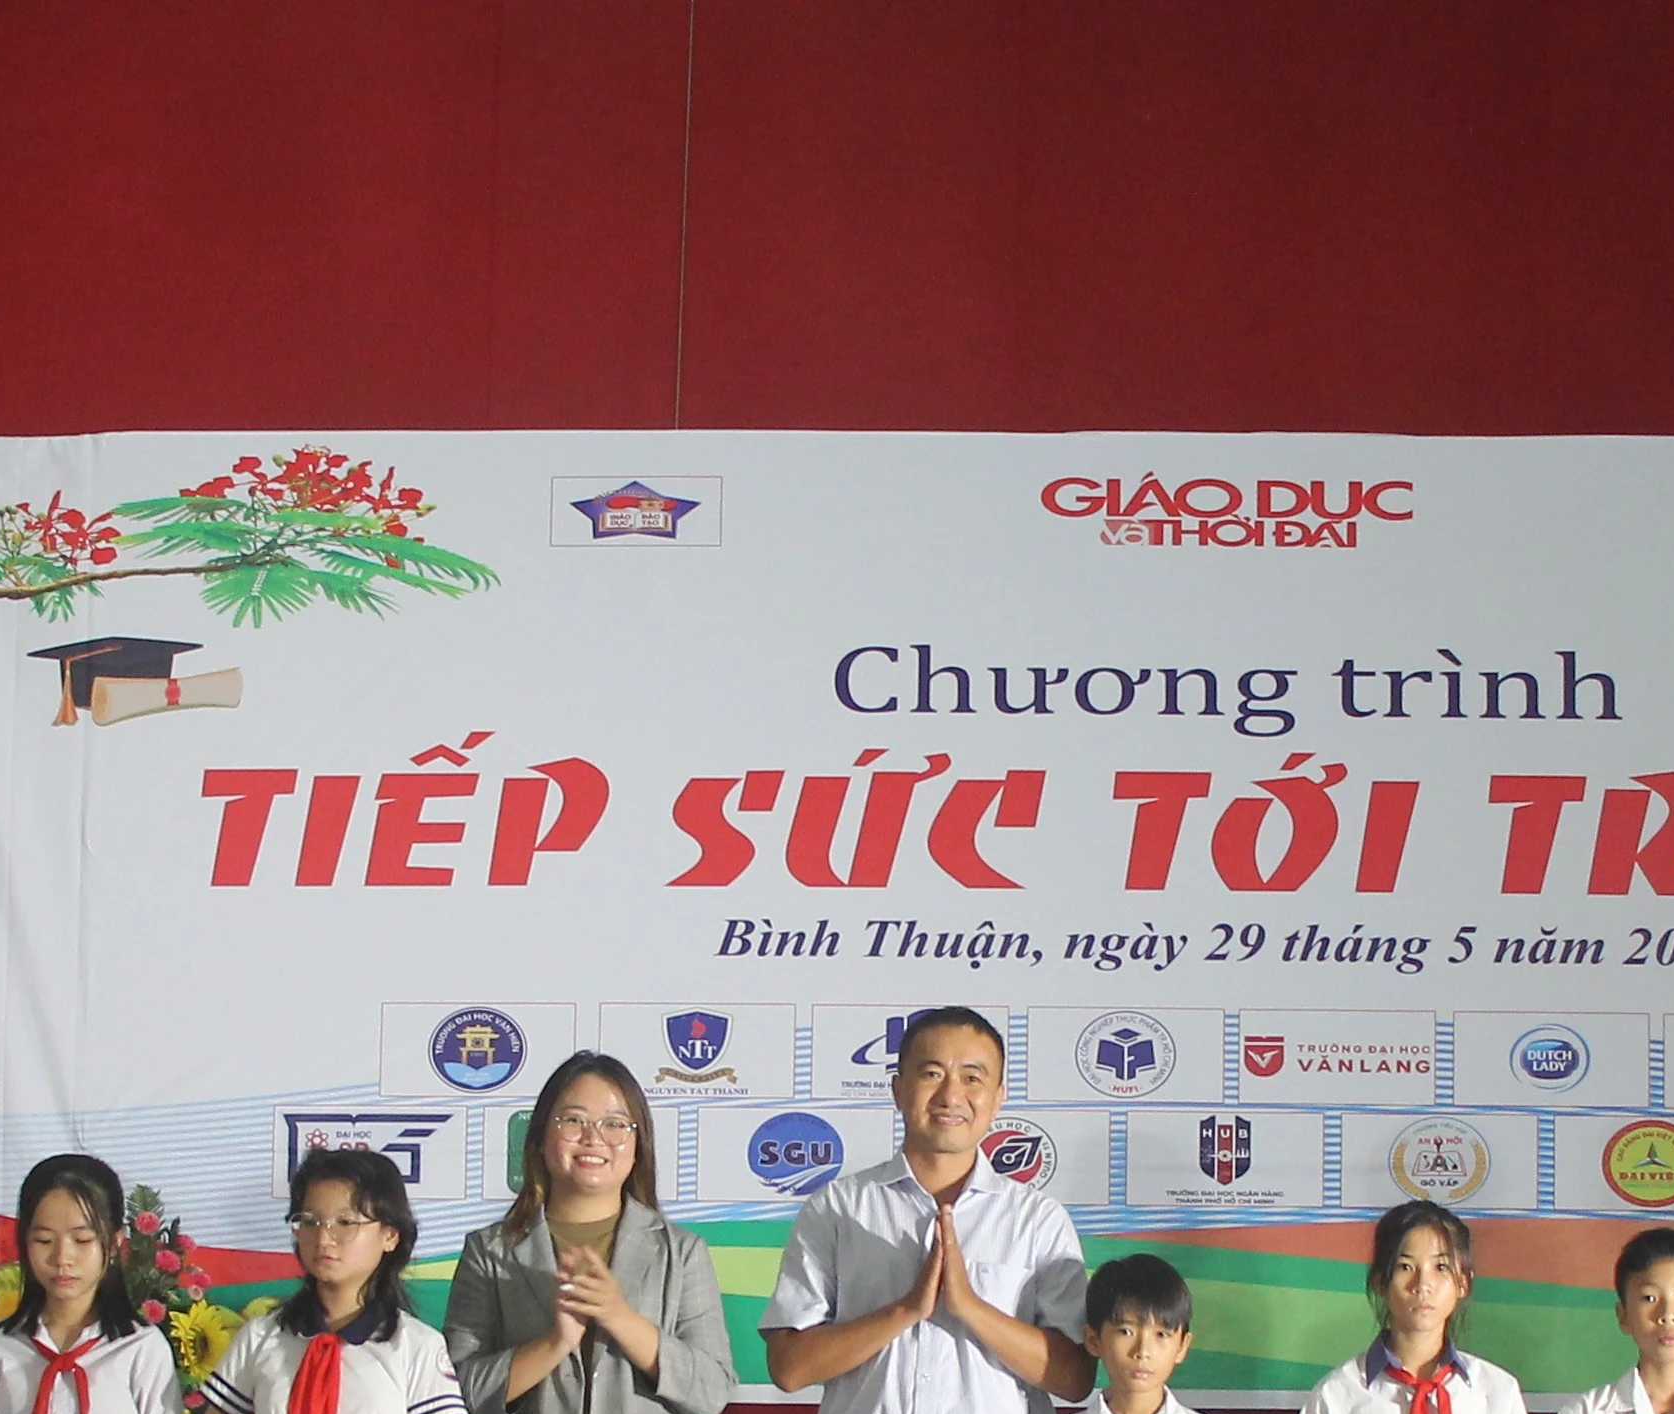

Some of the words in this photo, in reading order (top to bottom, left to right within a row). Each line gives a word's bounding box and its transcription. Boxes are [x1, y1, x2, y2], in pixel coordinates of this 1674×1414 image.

[1041, 471, 1243, 518] GIÁO
[833, 644, 1298, 738] Chương
[1331, 649, 1623, 720] trình
[201, 731, 609, 886] TIẾP
[664, 748, 1046, 887] SỨC
[1113, 752, 1421, 892] TỚI
[714, 918, 840, 959] Bình
[863, 917, 1045, 968] Thuận,
[1062, 924, 1189, 972] ngày
[1202, 921, 1267, 963] 29
[1282, 920, 1431, 973] tháng
[1446, 926, 1476, 965] 5
[1493, 928, 1605, 967] năm
[678, 1040, 717, 1058] NTT
[1297, 1043, 1362, 1053] TRƯỜNG
[1368, 1045, 1393, 1055] ĐẠI
[1399, 1046, 1431, 1055] HỌC
[1528, 1050, 1572, 1060] DUTCH
[1533, 1061, 1566, 1071] LADY
[758, 1140, 833, 1167] SGU
